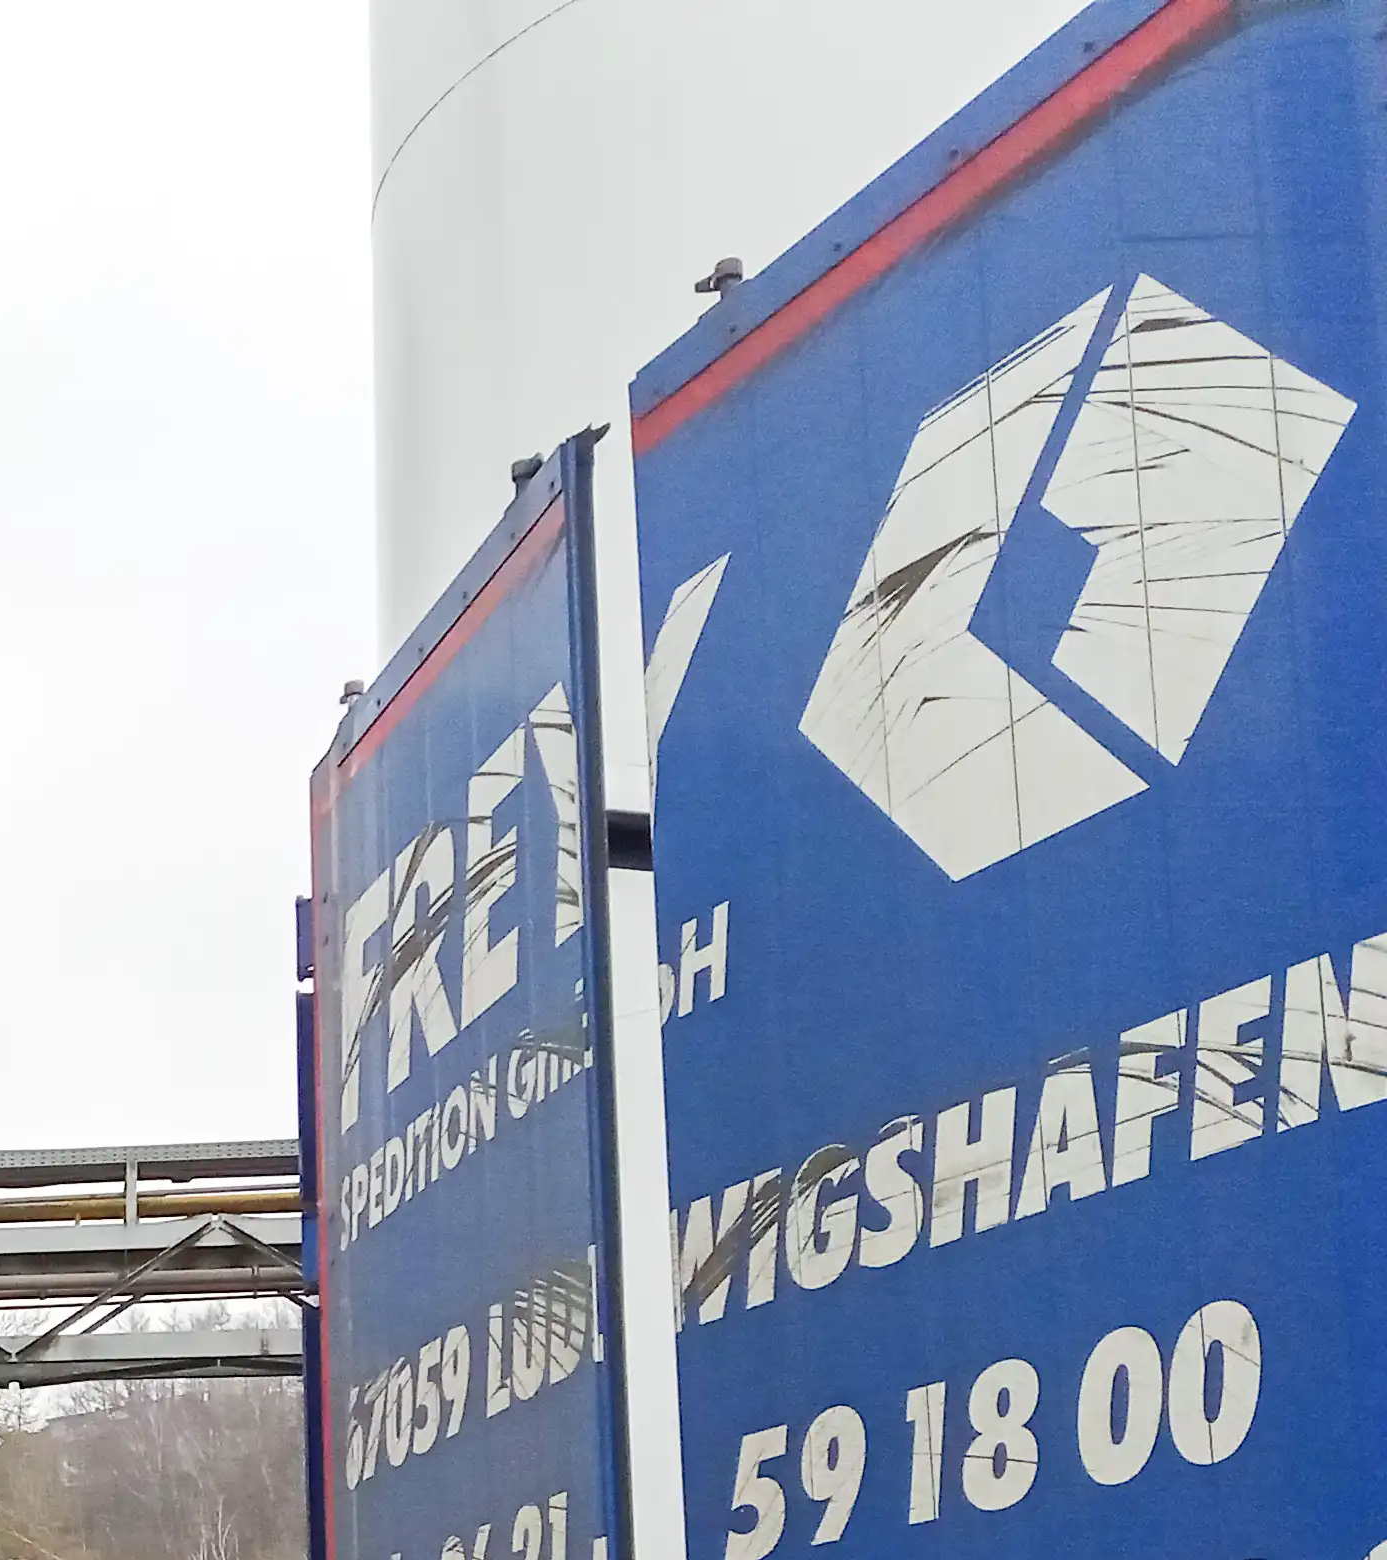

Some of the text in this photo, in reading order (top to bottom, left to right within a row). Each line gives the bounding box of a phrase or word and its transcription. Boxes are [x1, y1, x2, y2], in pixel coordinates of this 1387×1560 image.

[340, 1054, 497, 1252] SPEDITION
[907, 1358, 1039, 1526] 18
[1078, 1300, 1261, 1487] 00
